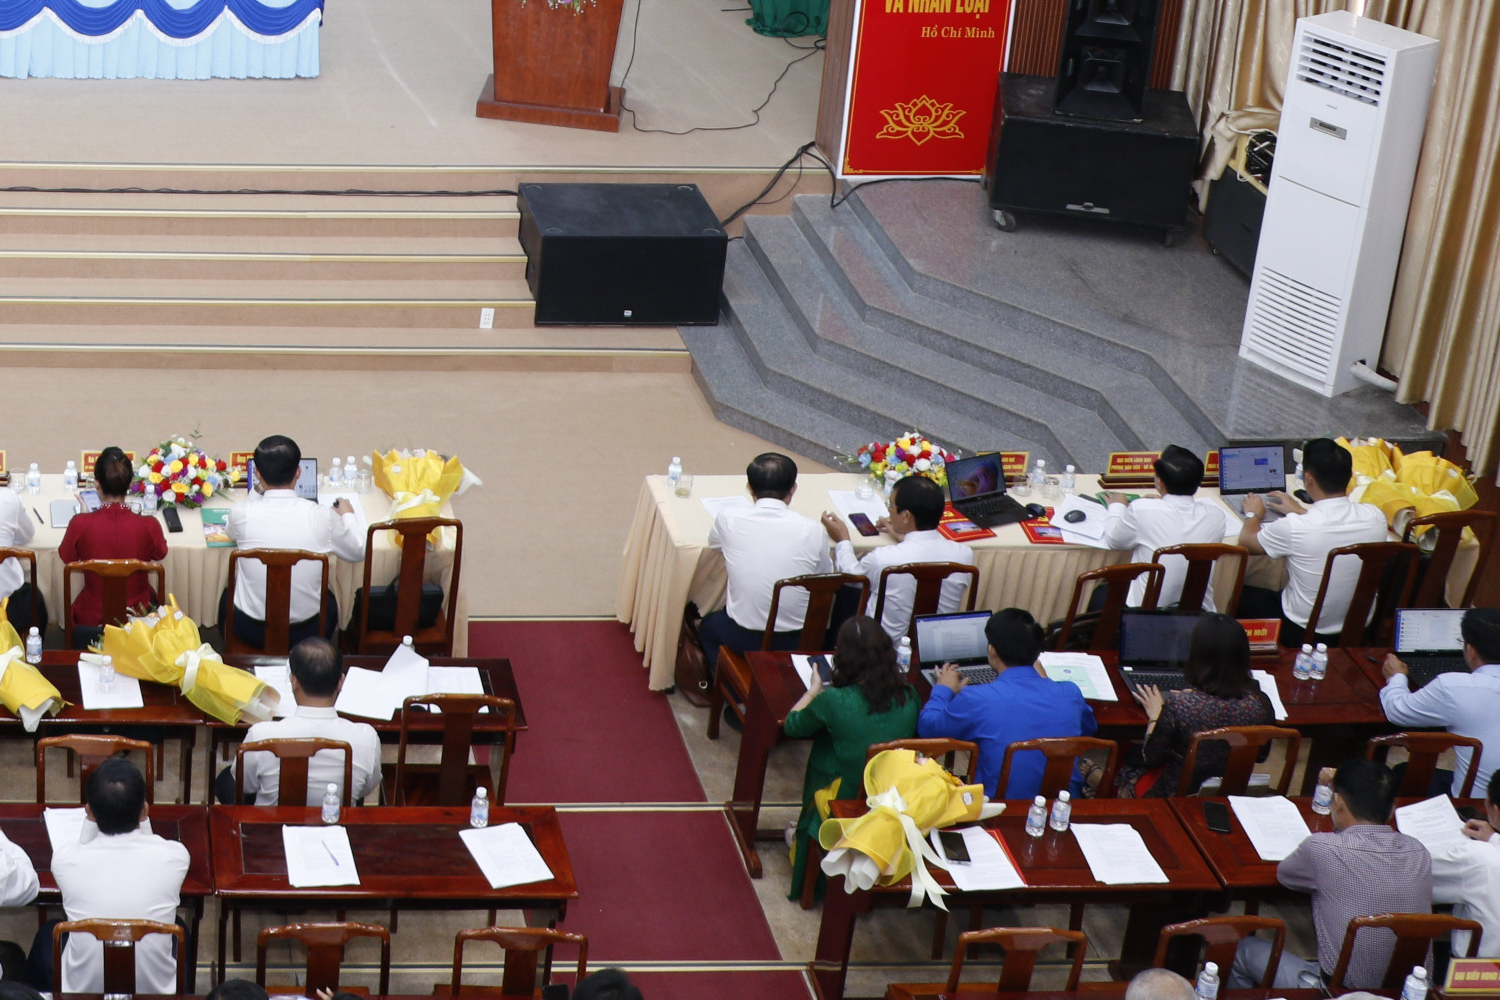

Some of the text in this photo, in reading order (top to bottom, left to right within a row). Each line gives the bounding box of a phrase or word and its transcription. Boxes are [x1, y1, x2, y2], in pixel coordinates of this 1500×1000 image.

[922, 25, 994, 38] Hồ Chí Minh
